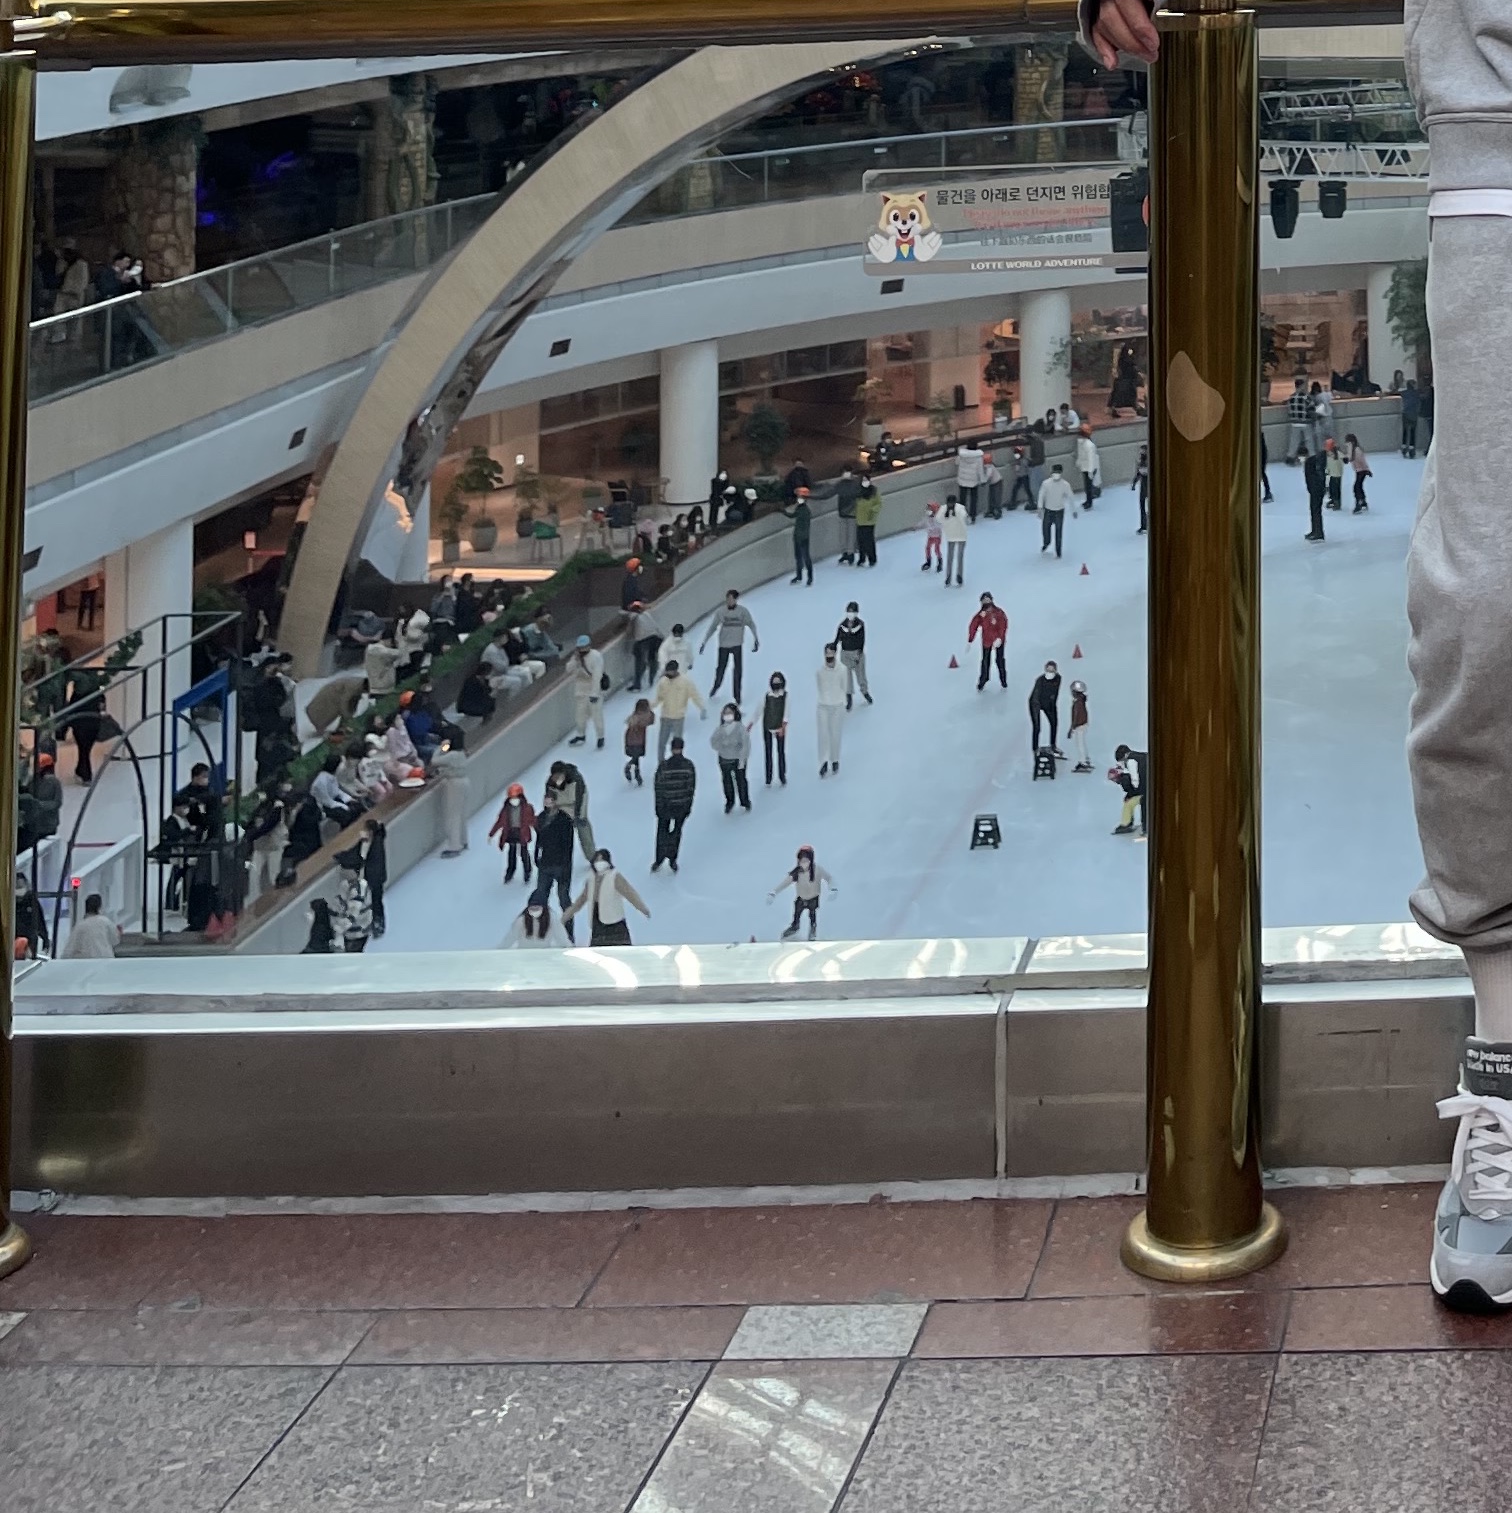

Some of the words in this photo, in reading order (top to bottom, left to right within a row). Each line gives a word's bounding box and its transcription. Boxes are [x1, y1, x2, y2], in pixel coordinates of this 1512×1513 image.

[936, 188, 977, 206] 물건을
[981, 187, 1022, 203] 아래로
[1026, 185, 1066, 202] 던지면
[1071, 183, 1112, 200] 위험합
[970, 261, 1003, 271] LOTTE
[1005, 259, 1042, 270] WORLD
[1043, 257, 1103, 268] ADVENTURE
